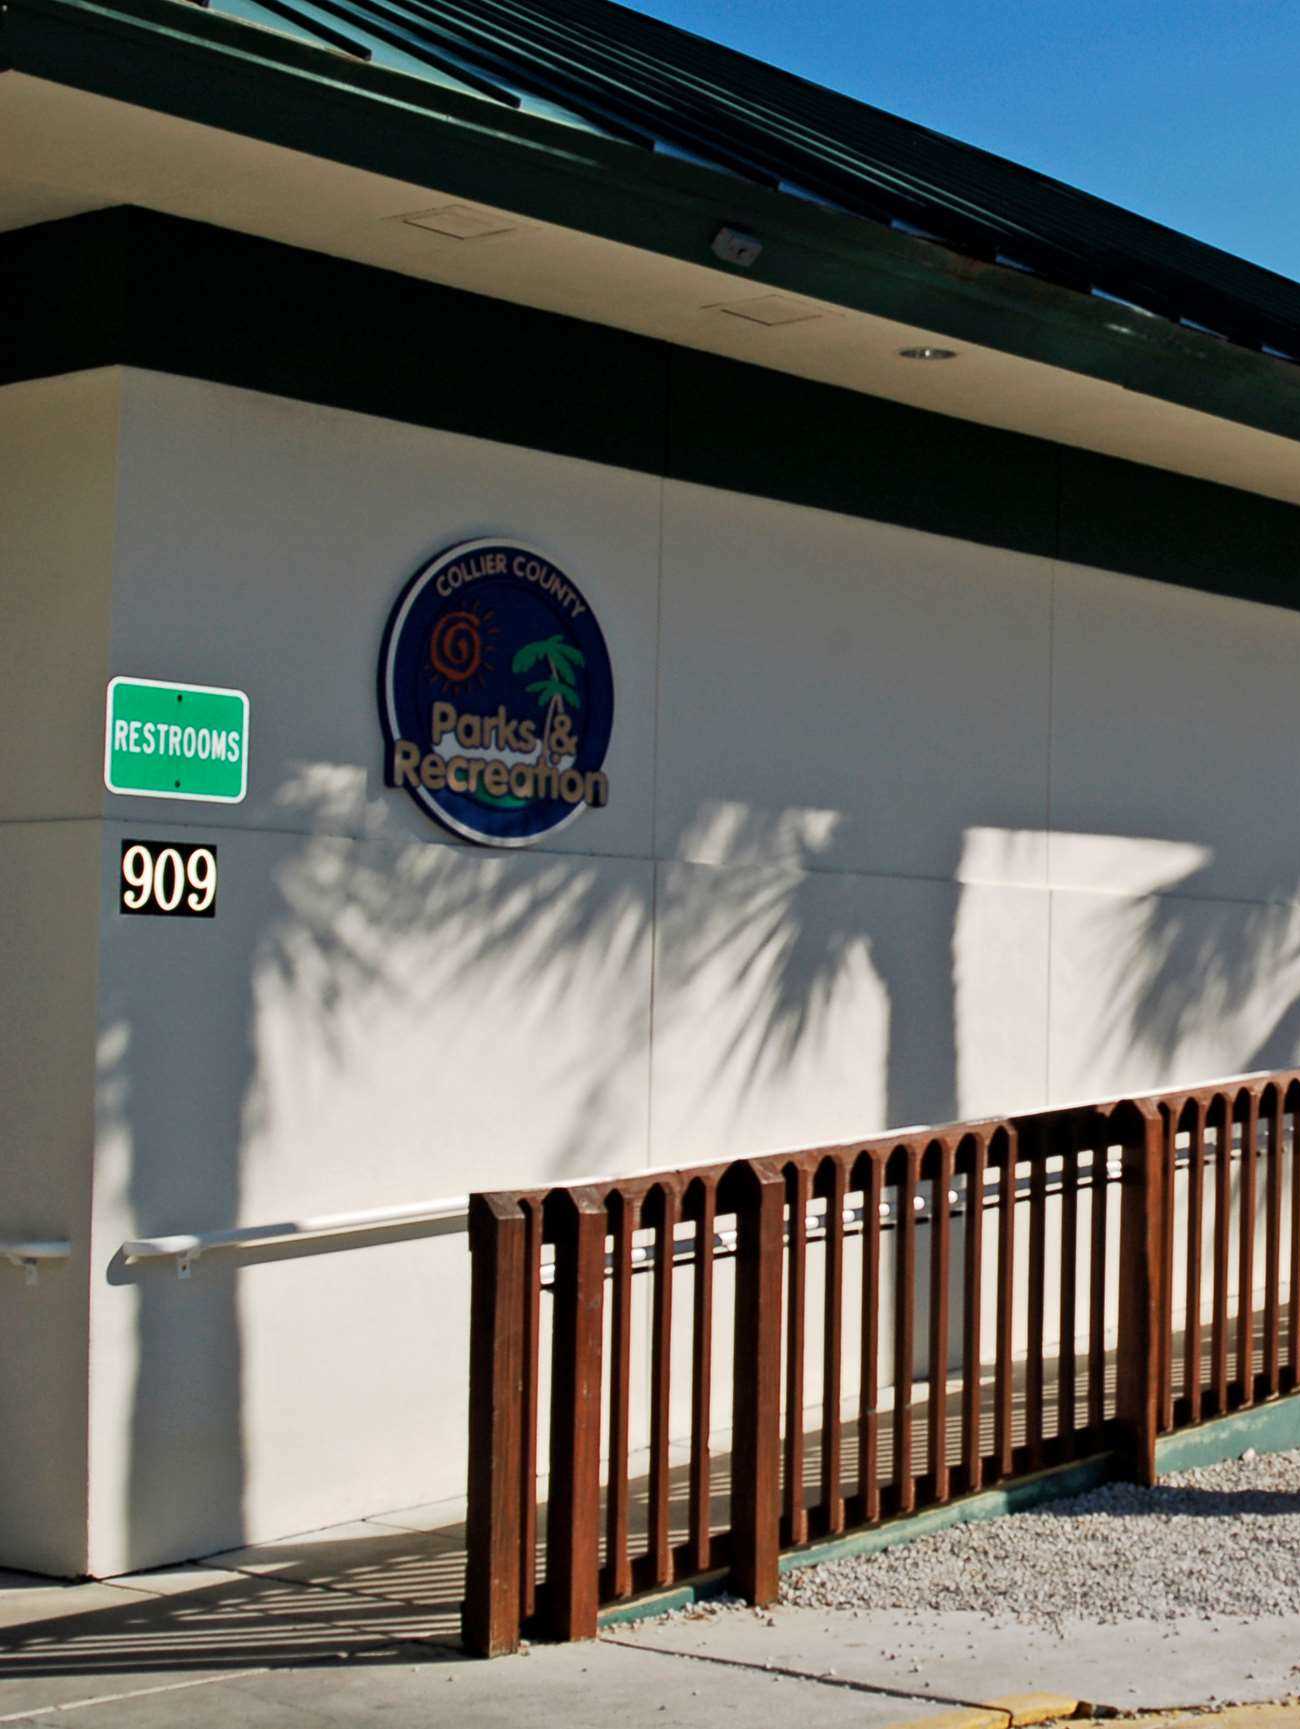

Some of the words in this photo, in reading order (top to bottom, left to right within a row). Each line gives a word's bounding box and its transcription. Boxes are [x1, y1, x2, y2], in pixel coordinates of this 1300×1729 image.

[436, 553, 508, 598] COLLIER
[512, 556, 586, 618] COUNTY
[114, 719, 240, 763] RESTROOMS
[432, 701, 538, 753] Parks
[550, 713, 578, 756] &
[393, 738, 608, 807] Recreation
[122, 845, 217, 911] 909
